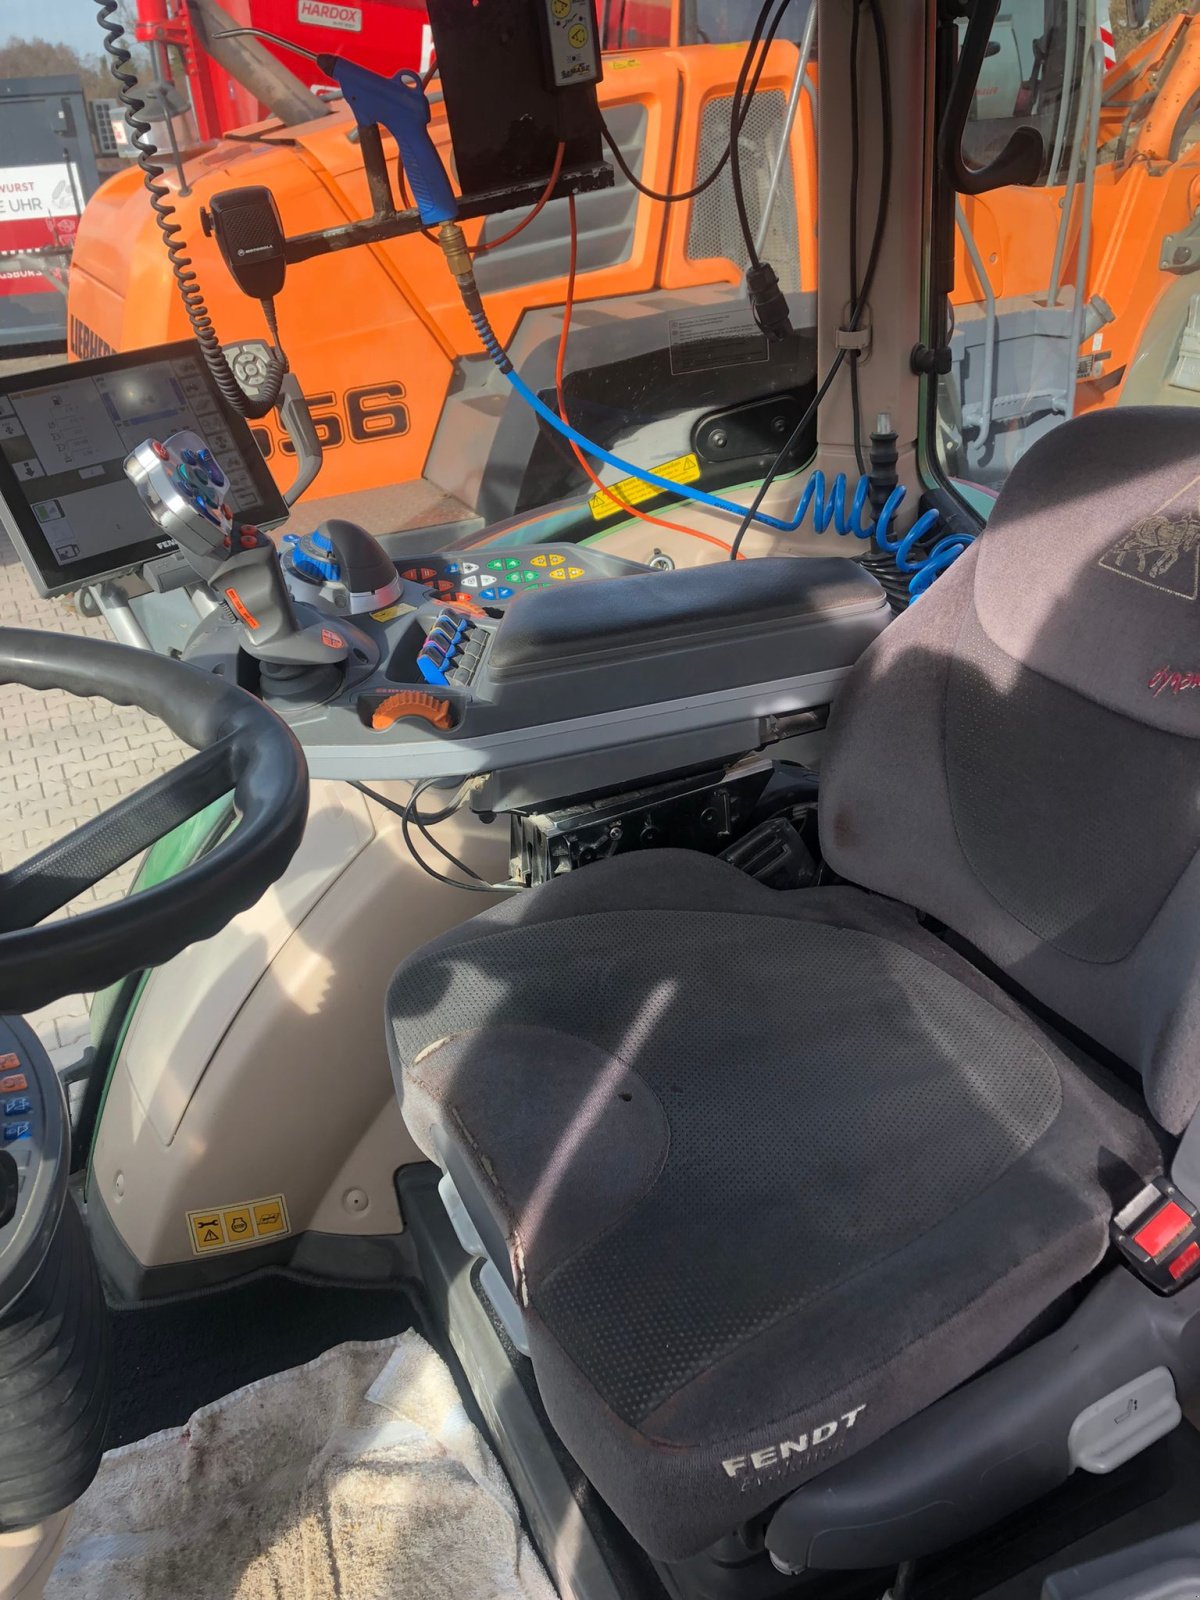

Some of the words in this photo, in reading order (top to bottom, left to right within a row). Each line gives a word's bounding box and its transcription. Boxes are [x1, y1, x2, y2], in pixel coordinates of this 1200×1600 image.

[301, 2, 357, 22] HARDOX
[8, 197, 43, 212] UHR
[722, 1403, 867, 1477] FENDT
